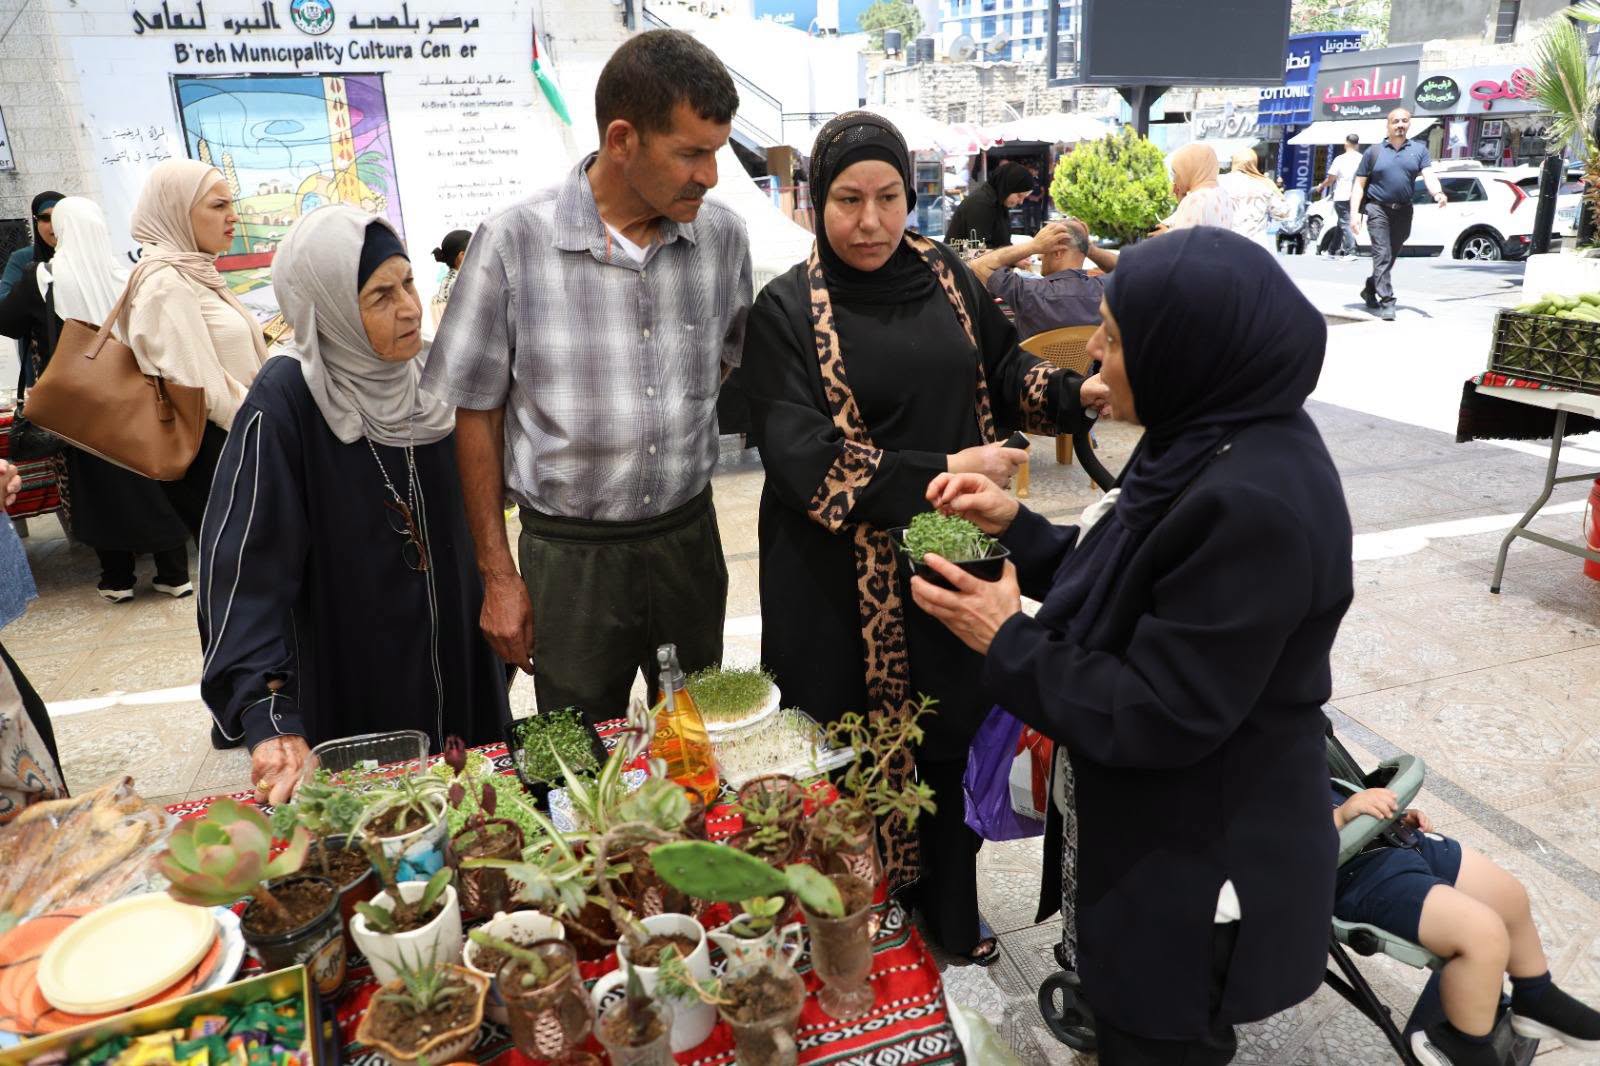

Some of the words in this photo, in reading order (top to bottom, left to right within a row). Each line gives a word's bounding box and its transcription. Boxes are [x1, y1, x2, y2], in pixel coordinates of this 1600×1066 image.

[1320, 38, 1361, 53] قطونيل
[230, 41, 344, 69] Municipality
[1259, 85, 1311, 99] COTTONIL
